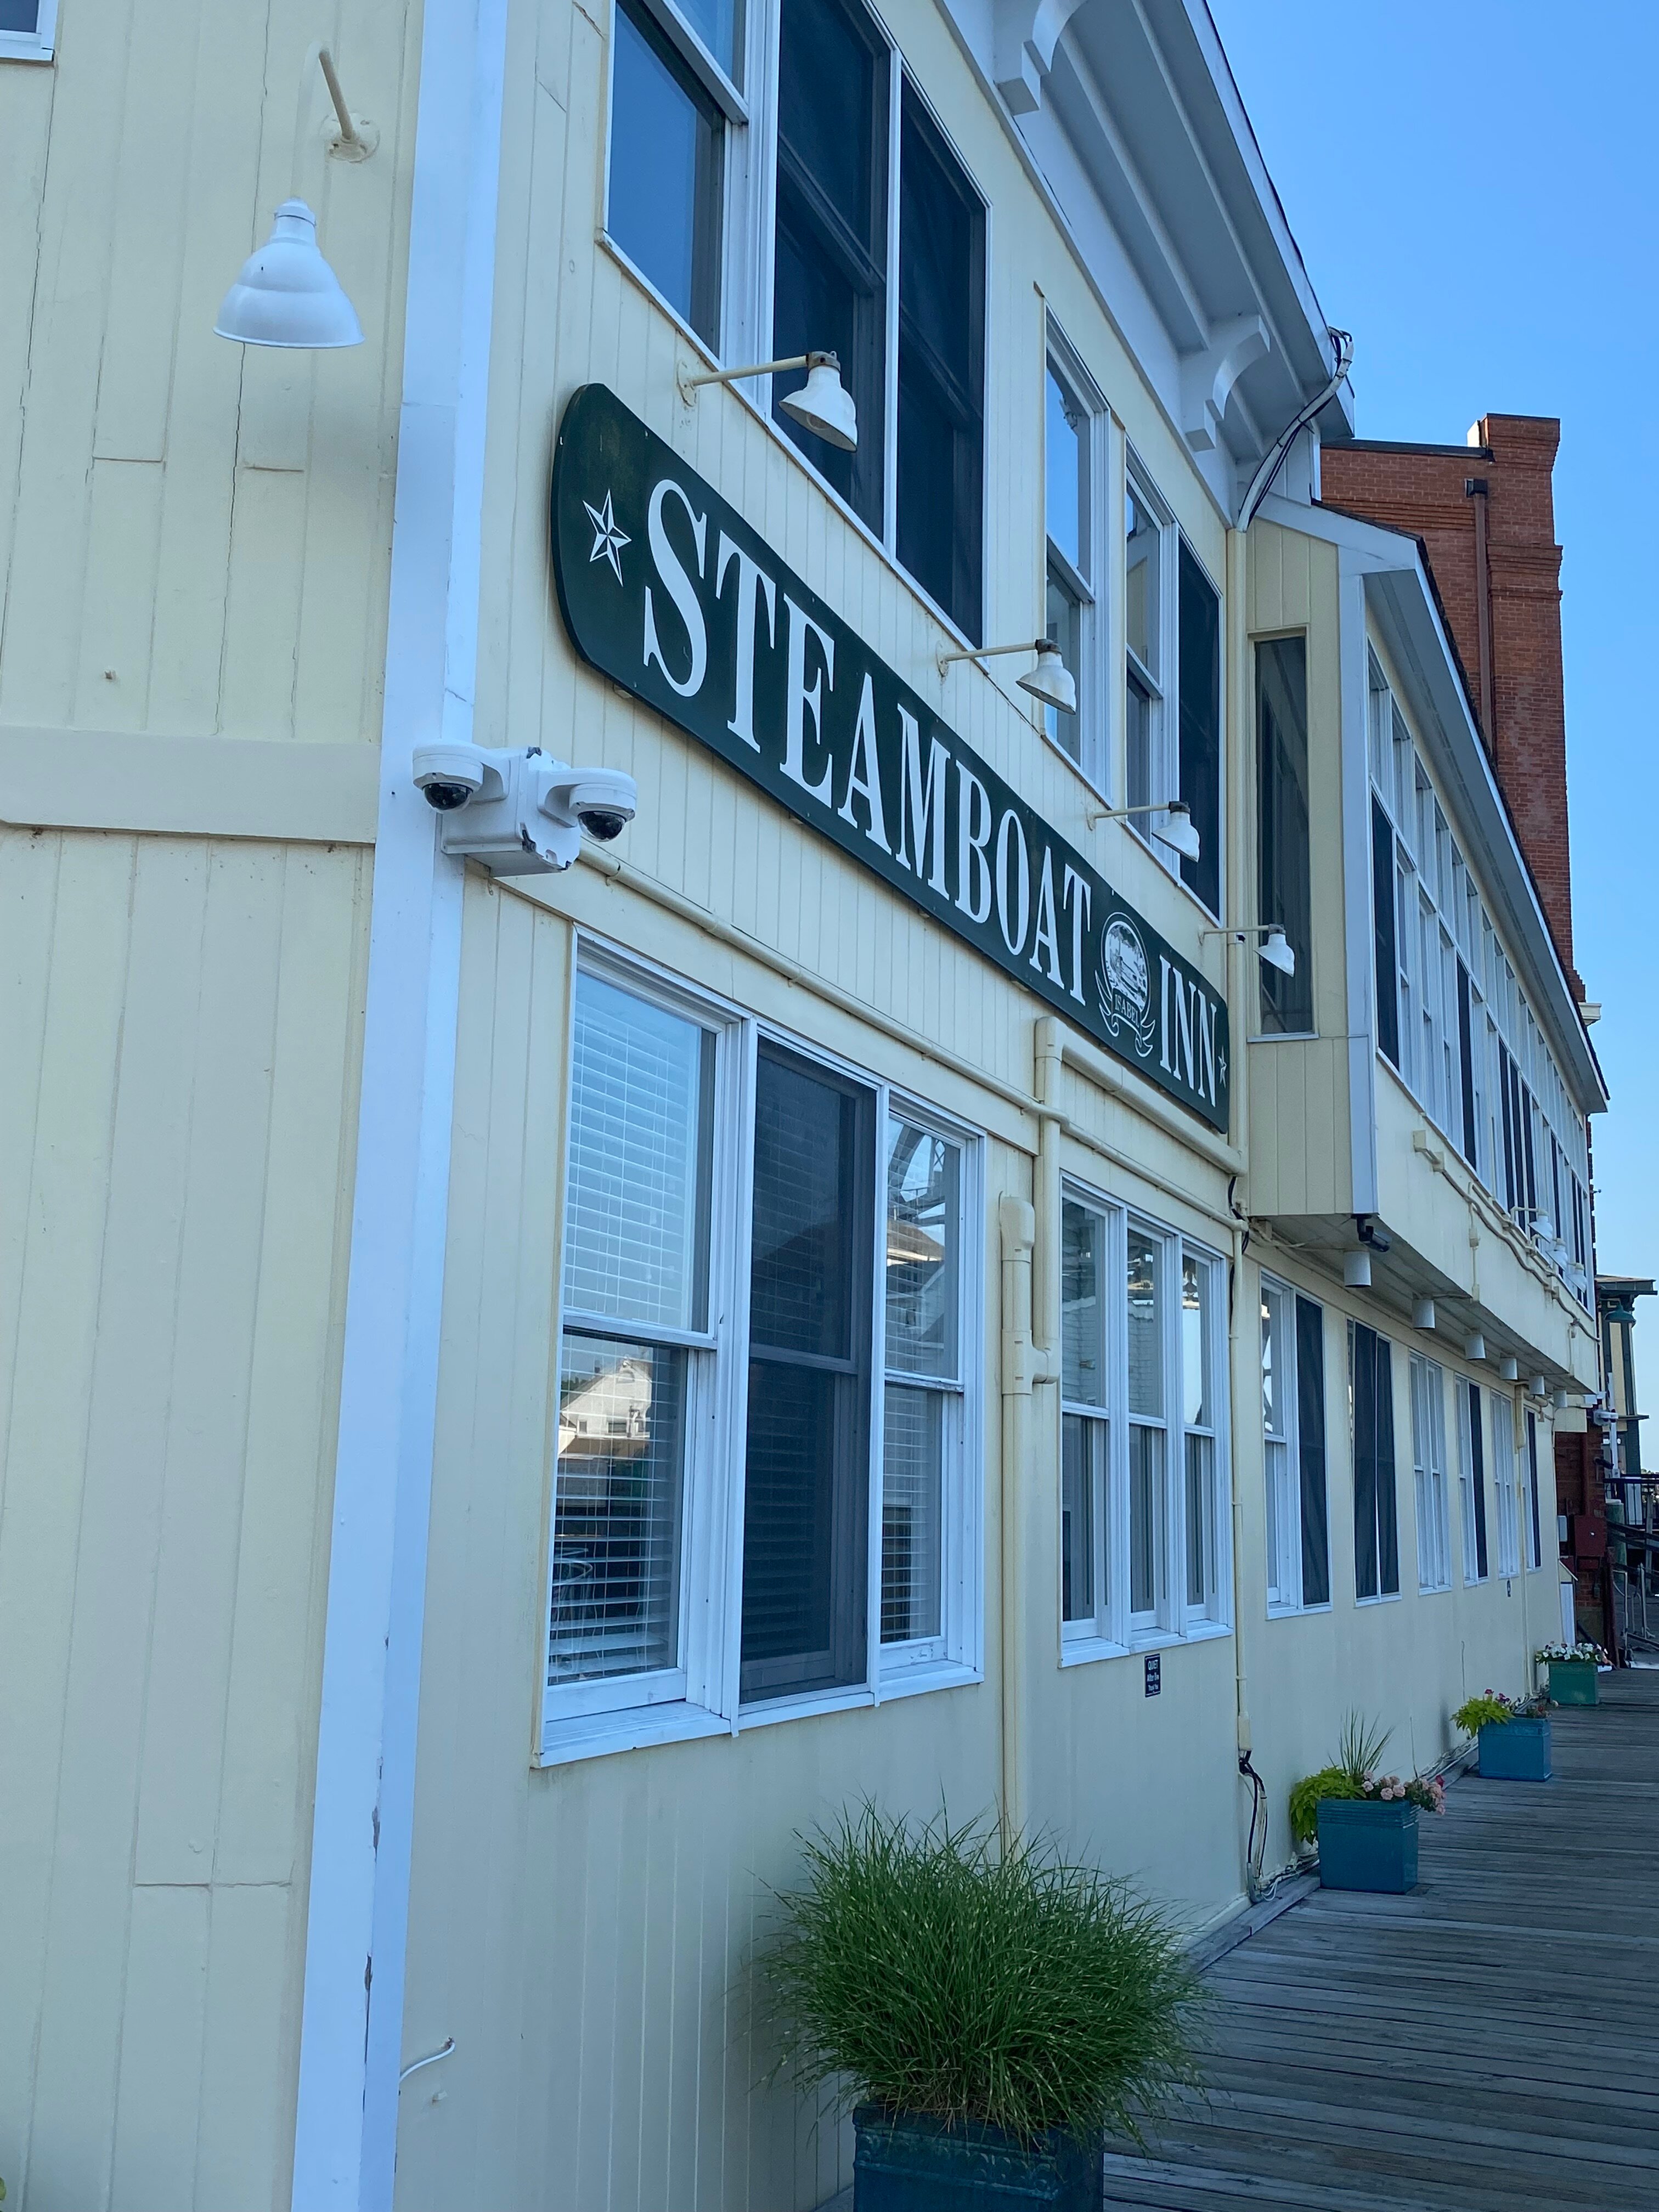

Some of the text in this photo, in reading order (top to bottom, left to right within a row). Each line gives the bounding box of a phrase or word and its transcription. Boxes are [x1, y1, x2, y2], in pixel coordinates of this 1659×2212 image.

[643, 478, 1217, 1108] STEAMBOAT INN
[1114, 994, 1139, 1029] ISABEL
